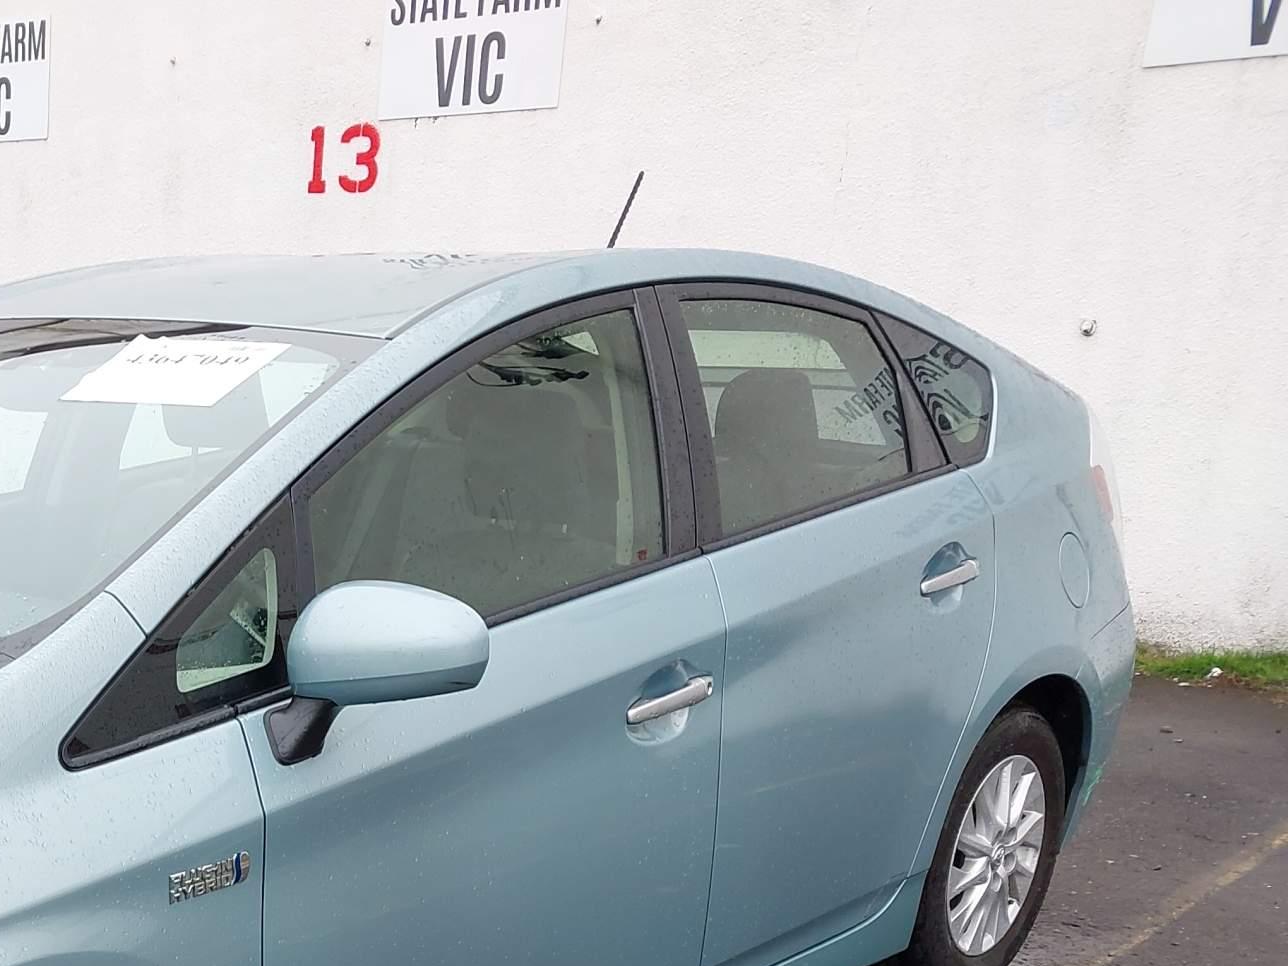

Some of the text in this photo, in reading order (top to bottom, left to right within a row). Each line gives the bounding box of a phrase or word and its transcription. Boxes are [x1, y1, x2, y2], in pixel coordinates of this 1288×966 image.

[435, 31, 506, 107] VIC
[308, 123, 380, 193] 13
[169, 873, 233, 905] HYBRID
